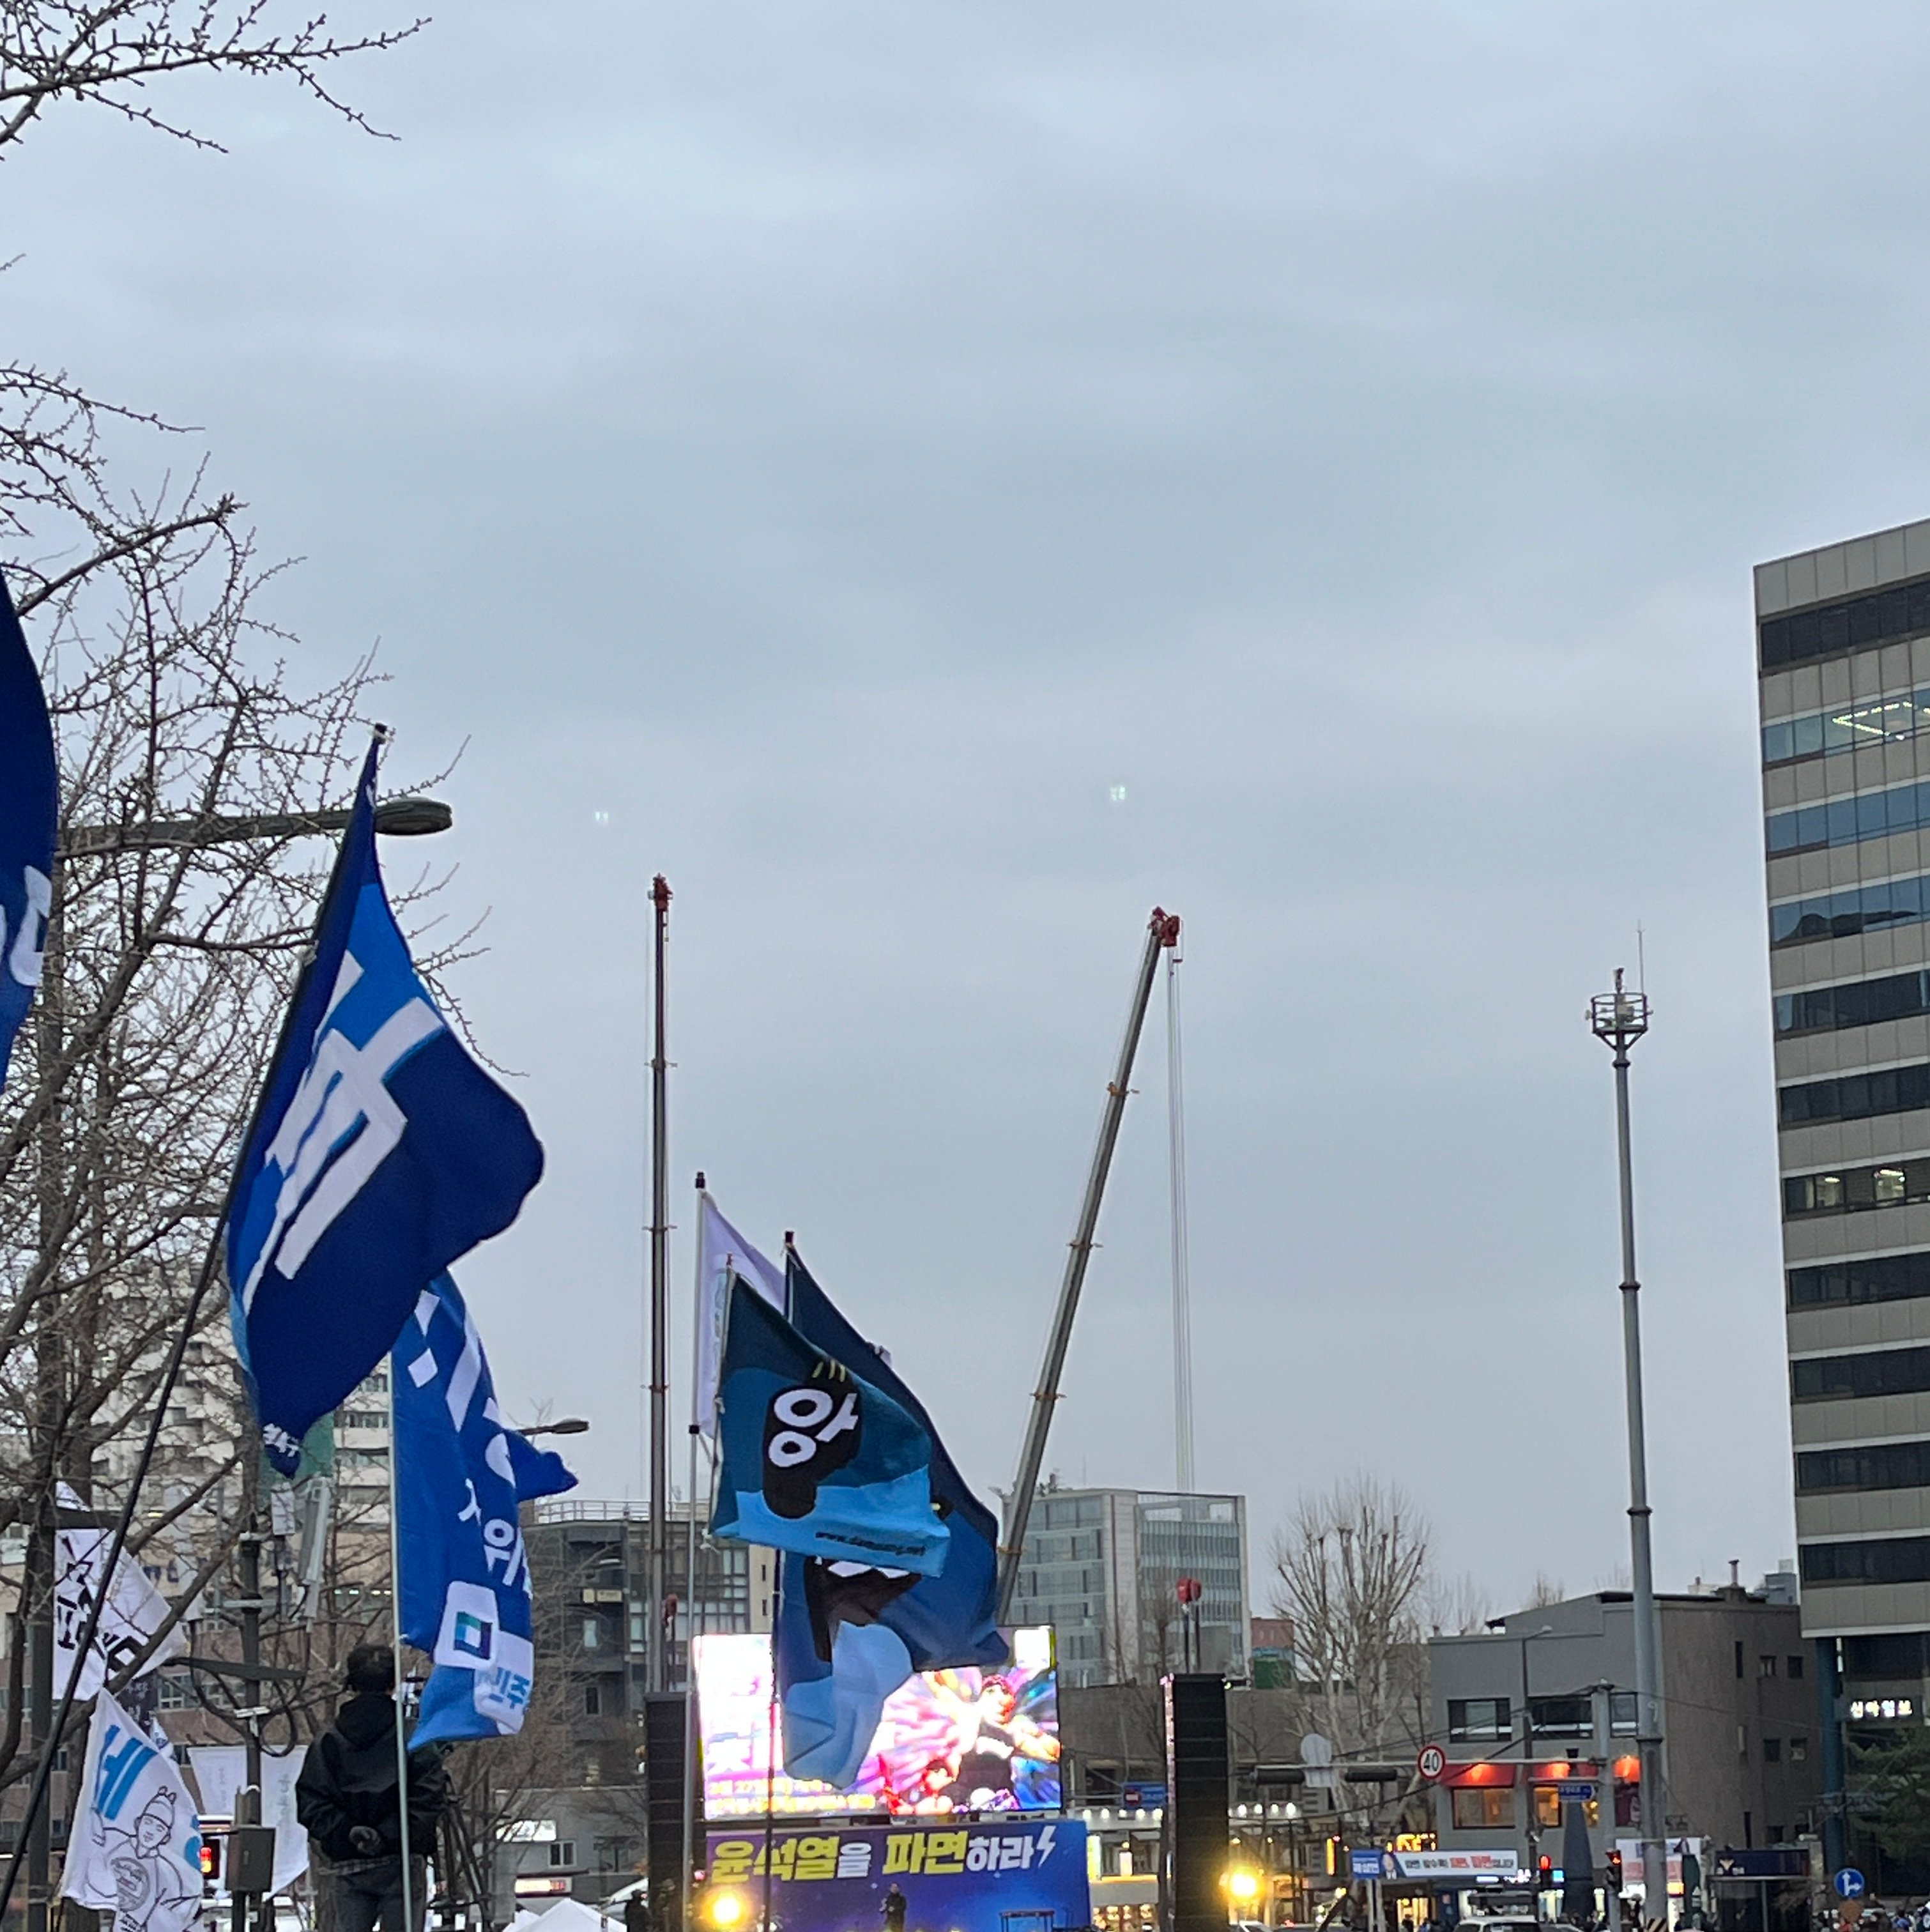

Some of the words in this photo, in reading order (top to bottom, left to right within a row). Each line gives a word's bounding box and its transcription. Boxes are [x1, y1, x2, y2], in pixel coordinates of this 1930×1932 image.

[768, 1388, 859, 1468] 앙
[1423, 1752, 1439, 1772] 40
[710, 1835, 873, 1883] 윤석열을
[882, 1830, 1034, 1875] 파면하라
